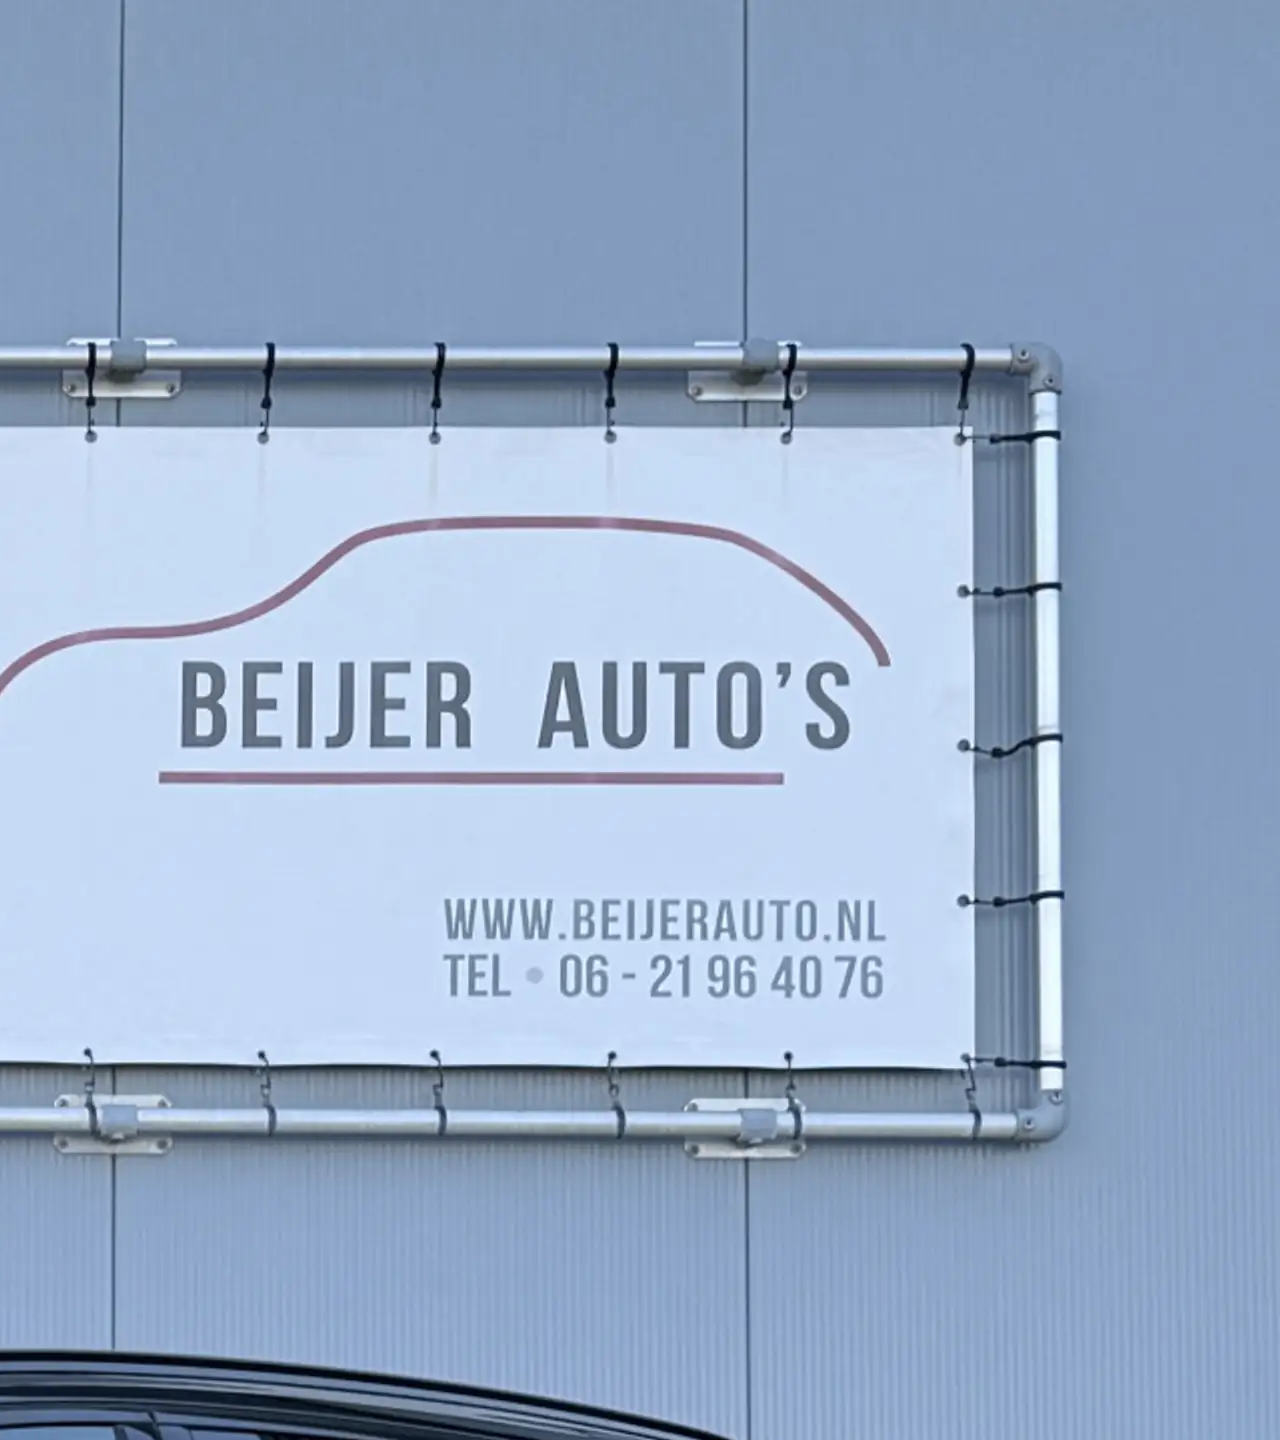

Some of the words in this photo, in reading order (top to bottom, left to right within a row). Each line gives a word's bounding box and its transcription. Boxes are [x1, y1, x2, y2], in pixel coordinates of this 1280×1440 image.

[180, 661, 473, 750] BEIJER
[538, 661, 852, 752] AUTO'S
[444, 899, 888, 943] WWW.BEIJERAUTO.NL
[443, 954, 513, 998] TEL
[560, 955, 610, 999] 06
[651, 955, 691, 999] 21
[708, 955, 758, 999] 96
[771, 956, 823, 1000] 40
[835, 956, 884, 1000] 76
